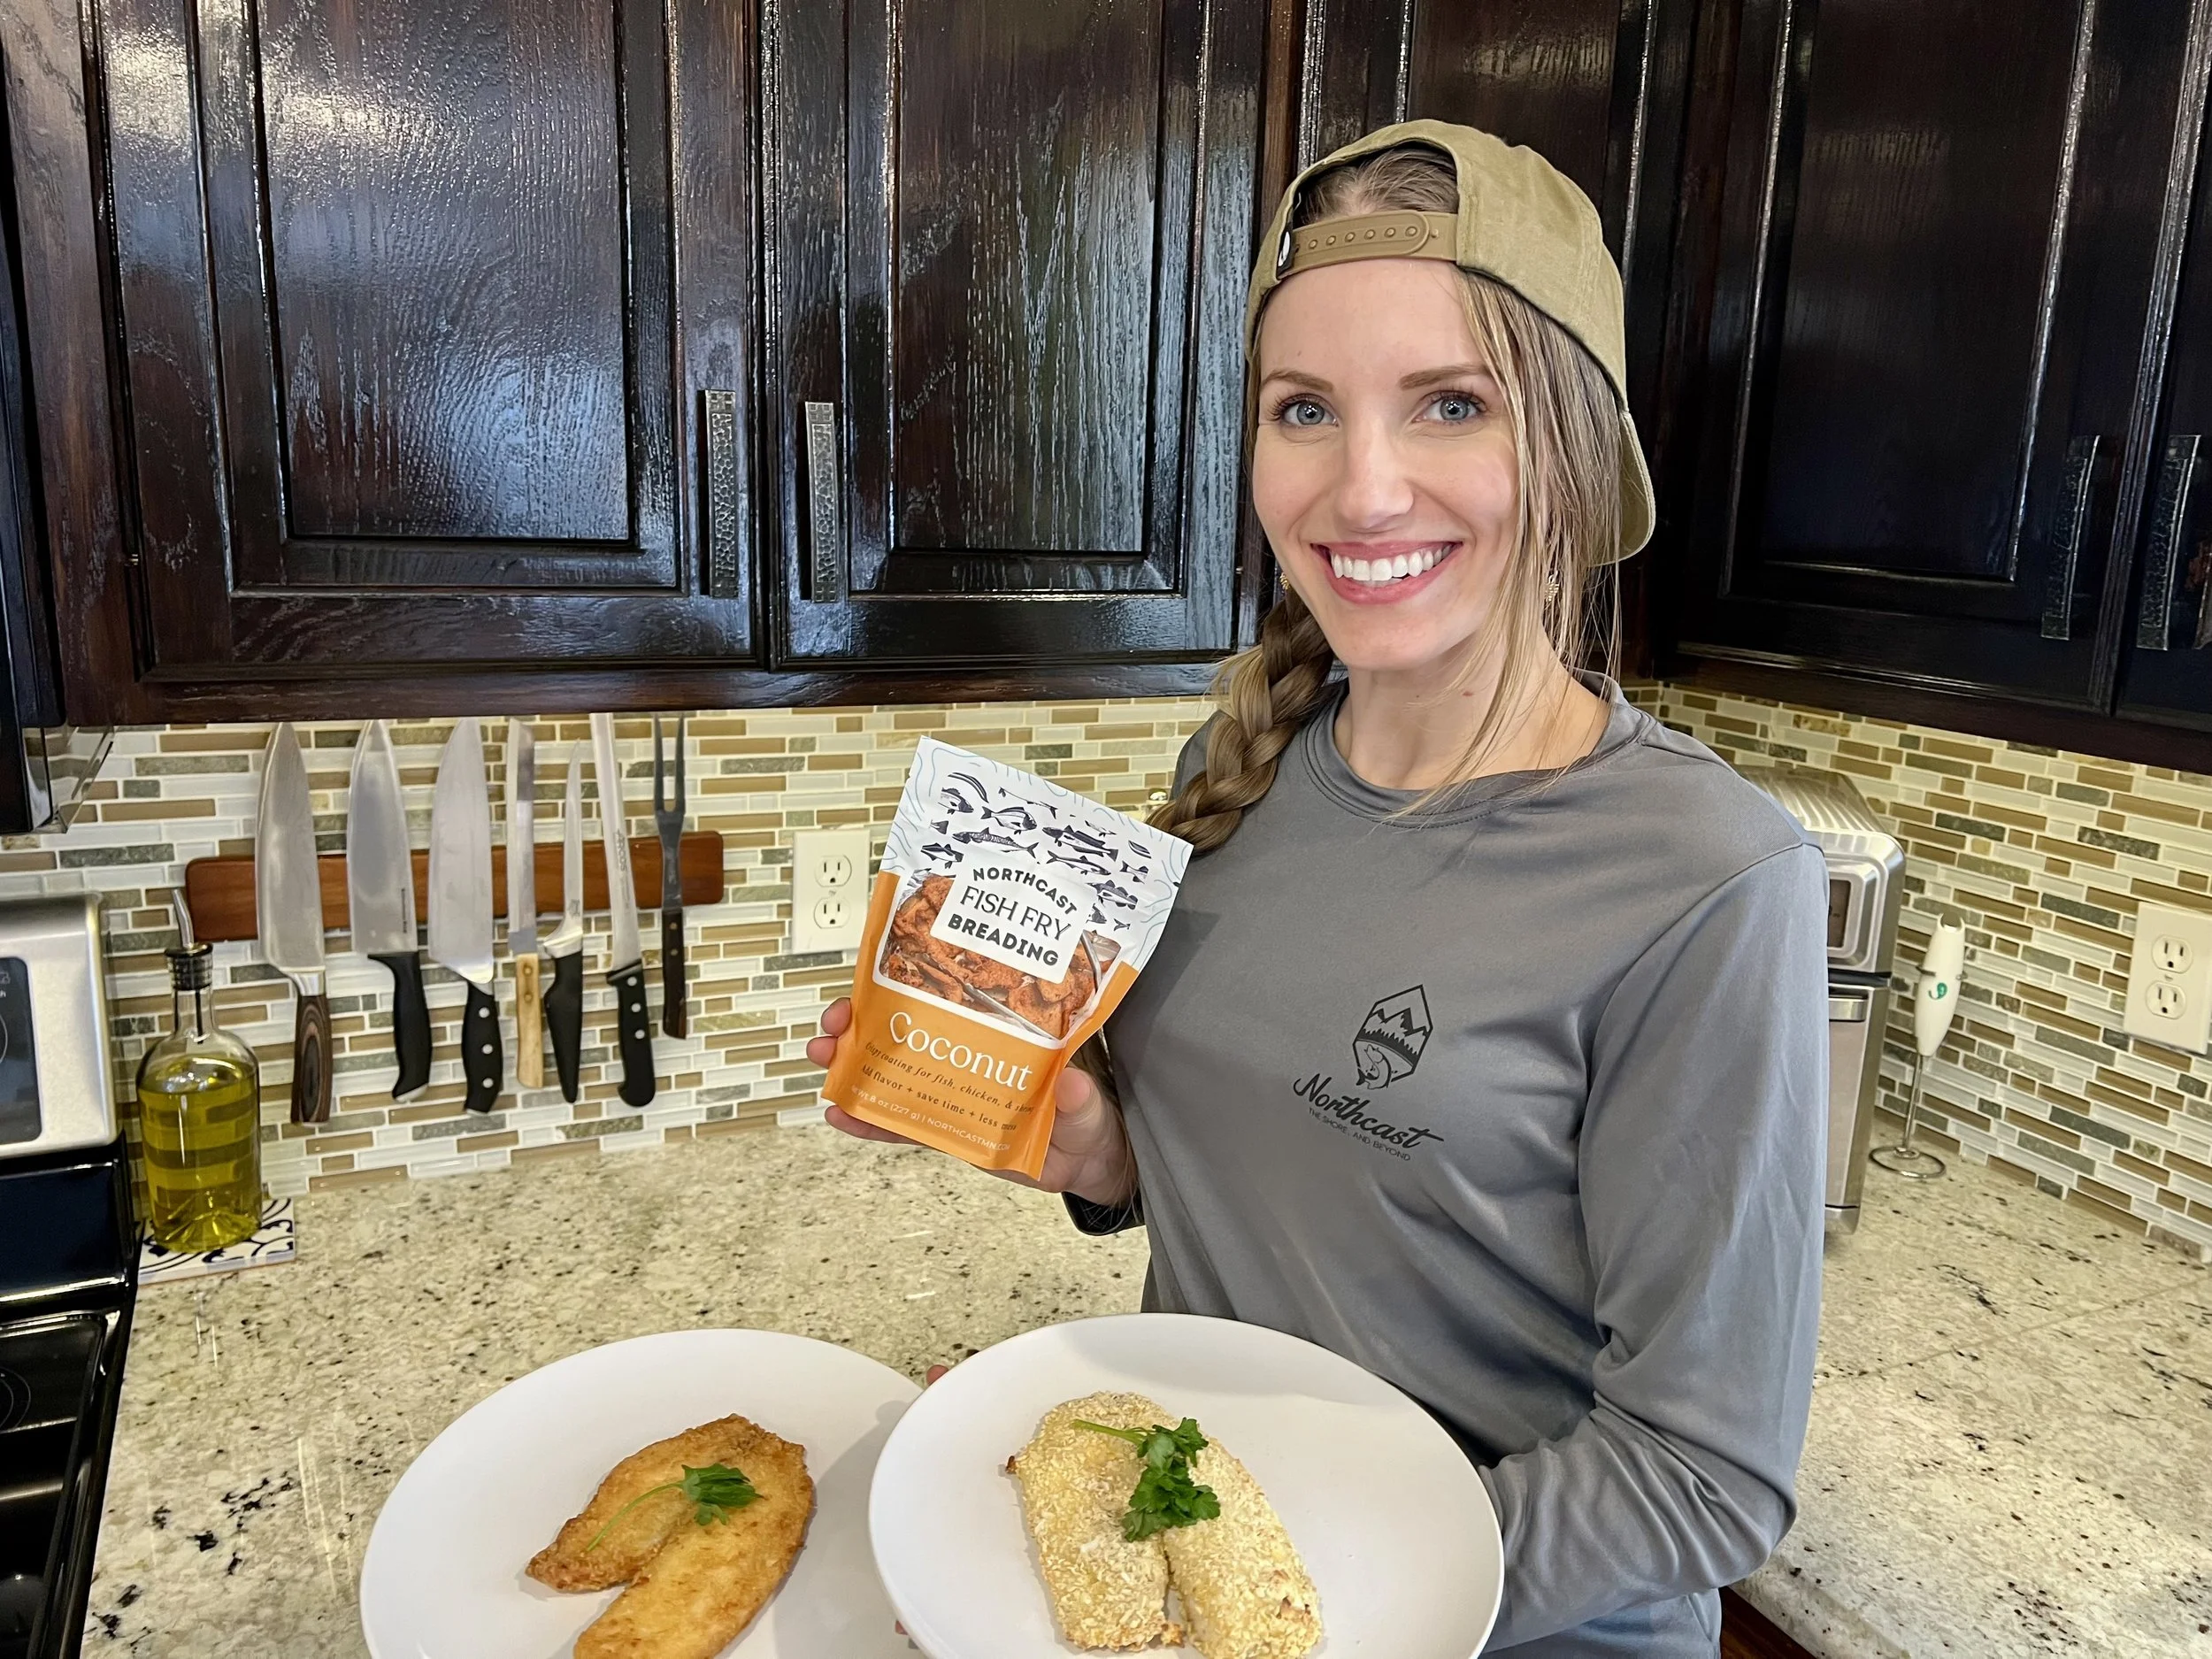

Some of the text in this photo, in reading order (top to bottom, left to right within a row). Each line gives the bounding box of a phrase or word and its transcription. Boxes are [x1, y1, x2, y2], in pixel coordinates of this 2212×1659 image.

[960, 885, 1071, 941] FISH FRY
[973, 867, 1077, 915] NORTHCAST
[948, 913, 1058, 966] BREADING
[889, 1011, 1033, 1091] Coconut
[870, 1094, 877, 1103] 8
[890, 1103, 910, 1115] (227
[873, 1071, 902, 1091] flavor
[917, 1092, 939, 1105] save
[942, 1100, 965, 1115] time
[979, 1113, 998, 1127] less
[880, 1053, 913, 1073] coating
[913, 1067, 932, 1079] for
[932, 1073, 956, 1089] fish,
[960, 1081, 1001, 1106] chicken,
[1004, 1100, 1013, 1110] &
[1293, 1073, 1444, 1148] Northcast
[1352, 1132, 1371, 1145] AND
[1372, 1141, 1410, 1161] BEYOND
